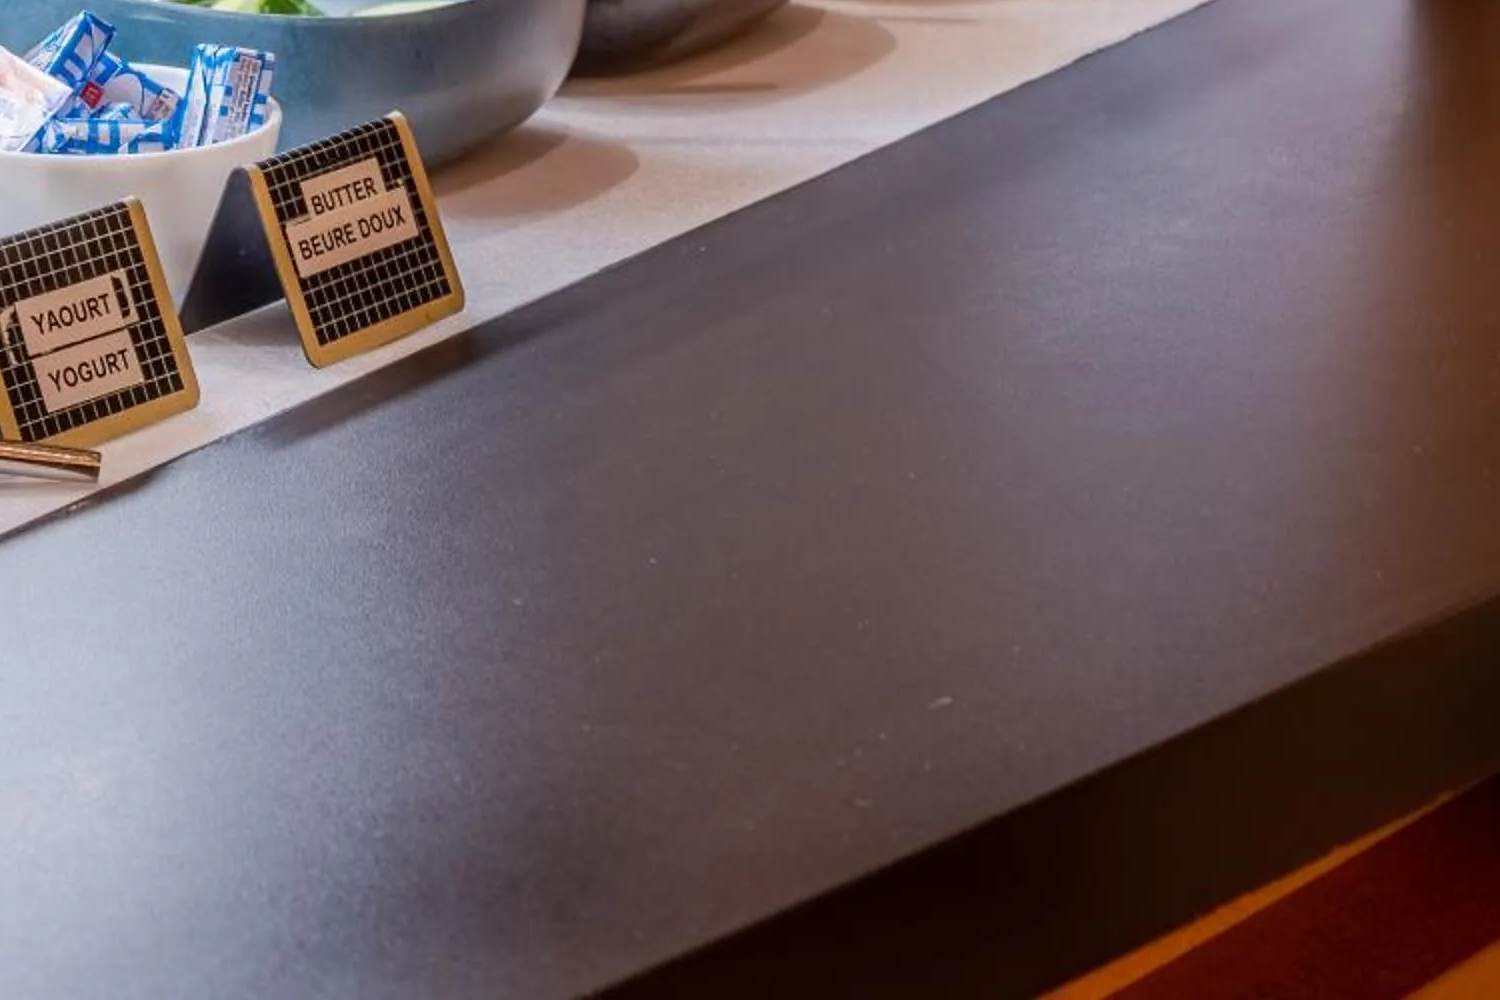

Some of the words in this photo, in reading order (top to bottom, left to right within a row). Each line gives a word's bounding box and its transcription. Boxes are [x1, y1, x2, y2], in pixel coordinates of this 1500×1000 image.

[310, 176, 379, 216] BUTTER
[298, 223, 357, 261] BEURE
[357, 206, 407, 243] DOUX
[31, 292, 112, 337] YAOURT
[47, 347, 131, 393] YOGURT
